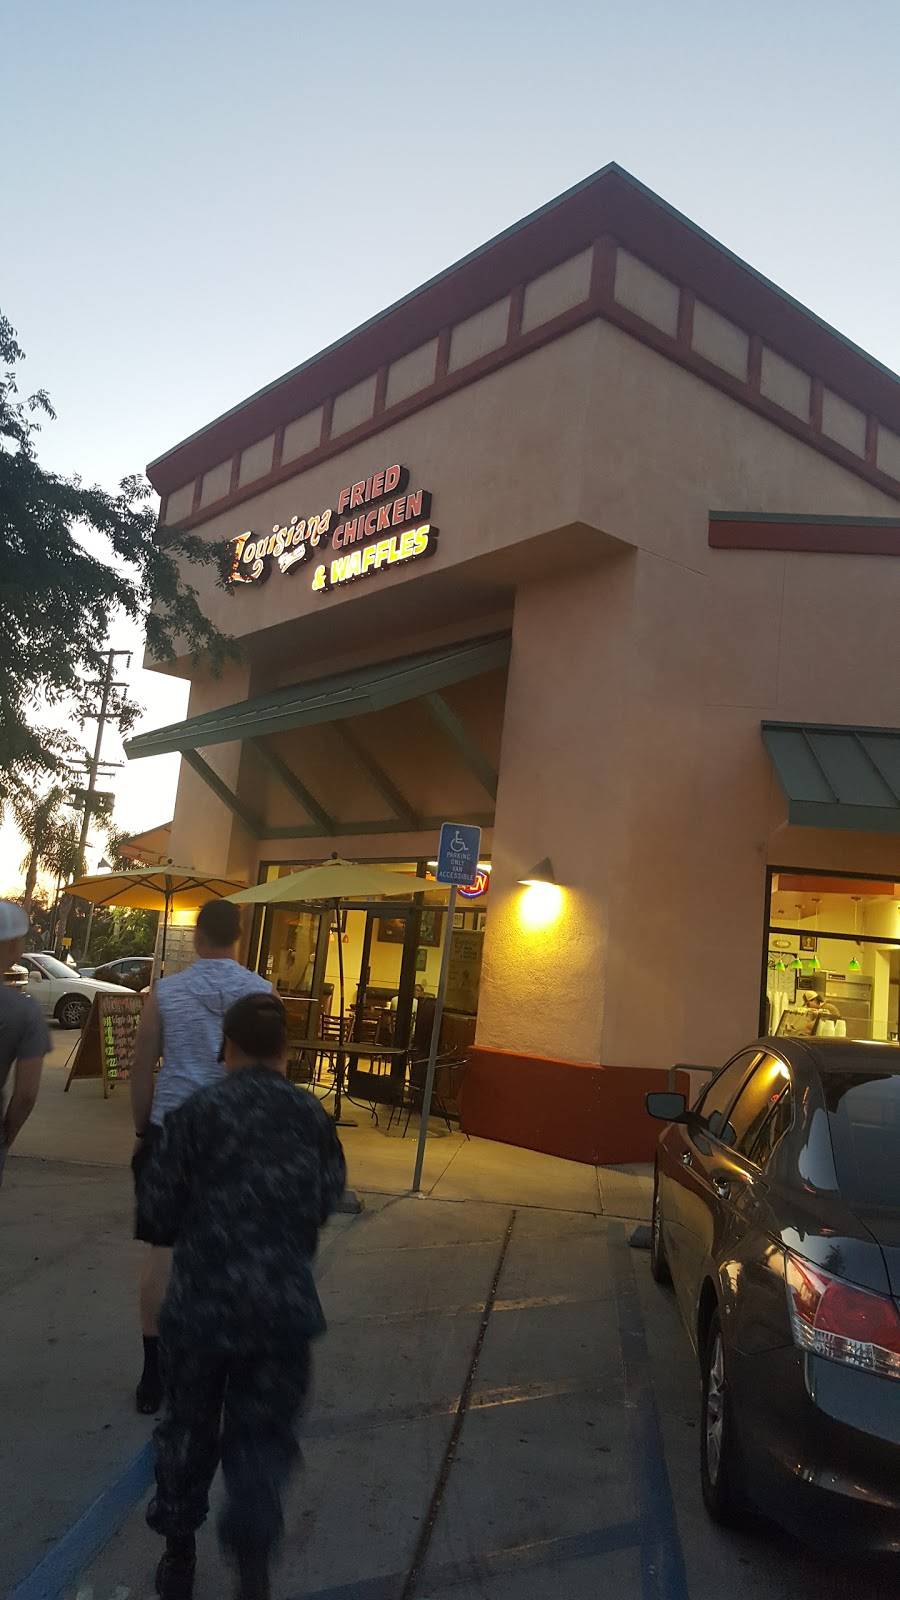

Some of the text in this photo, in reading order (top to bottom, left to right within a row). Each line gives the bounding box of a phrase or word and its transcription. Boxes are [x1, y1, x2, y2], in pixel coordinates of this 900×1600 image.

[338, 465, 401, 514] FRIED
[228, 509, 332, 583] Louisiana
[332, 490, 423, 550] CHICKEN
[312, 565, 326, 591] &
[331, 525, 431, 584] WAFFLES
[439, 871, 474, 881] ACCESSIBLE
[446, 851, 472, 860] PARKING
